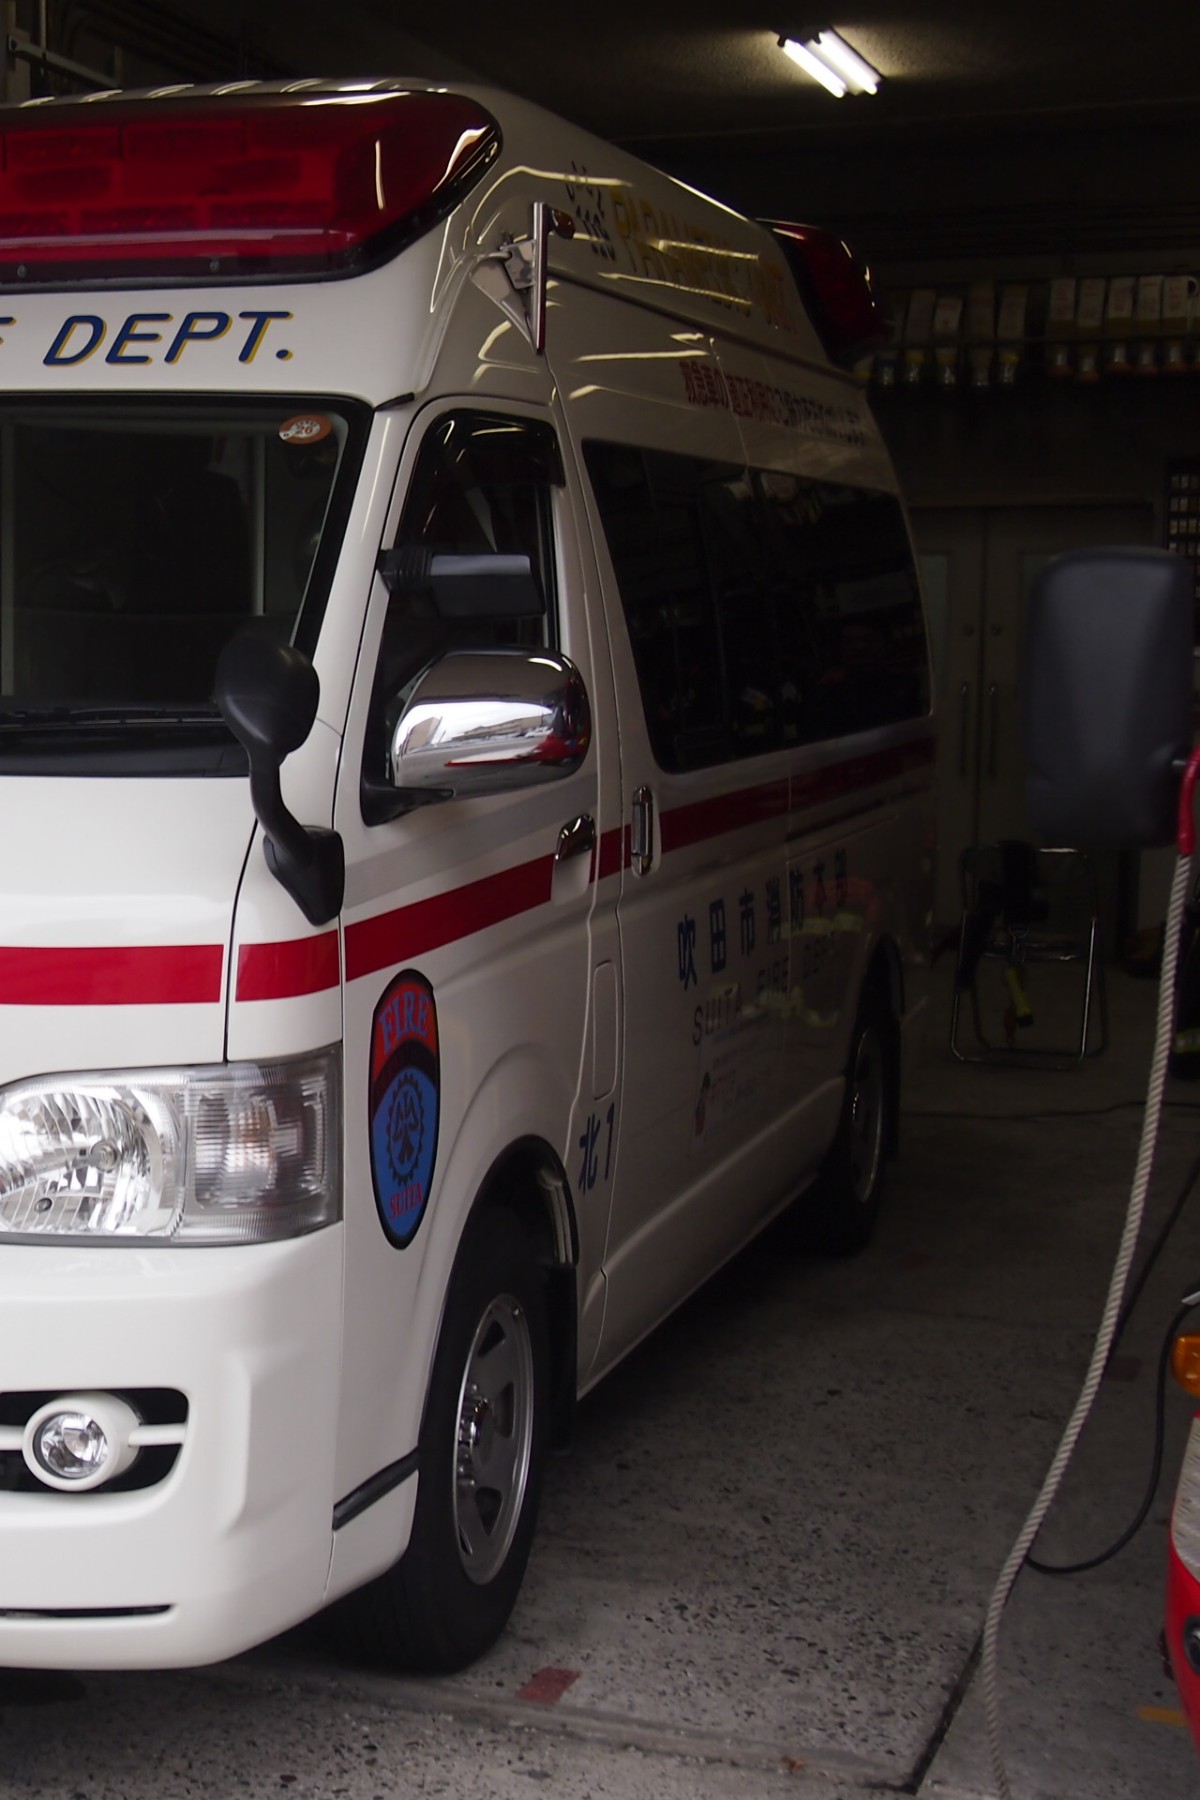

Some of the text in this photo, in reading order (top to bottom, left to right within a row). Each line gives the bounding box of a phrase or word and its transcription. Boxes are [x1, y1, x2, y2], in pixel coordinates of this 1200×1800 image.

[42, 311, 293, 368] DEPT.
[379, 991, 429, 1056] FIRE
[692, 982, 743, 1046] SUITA
[389, 1182, 424, 1219] SUITA
